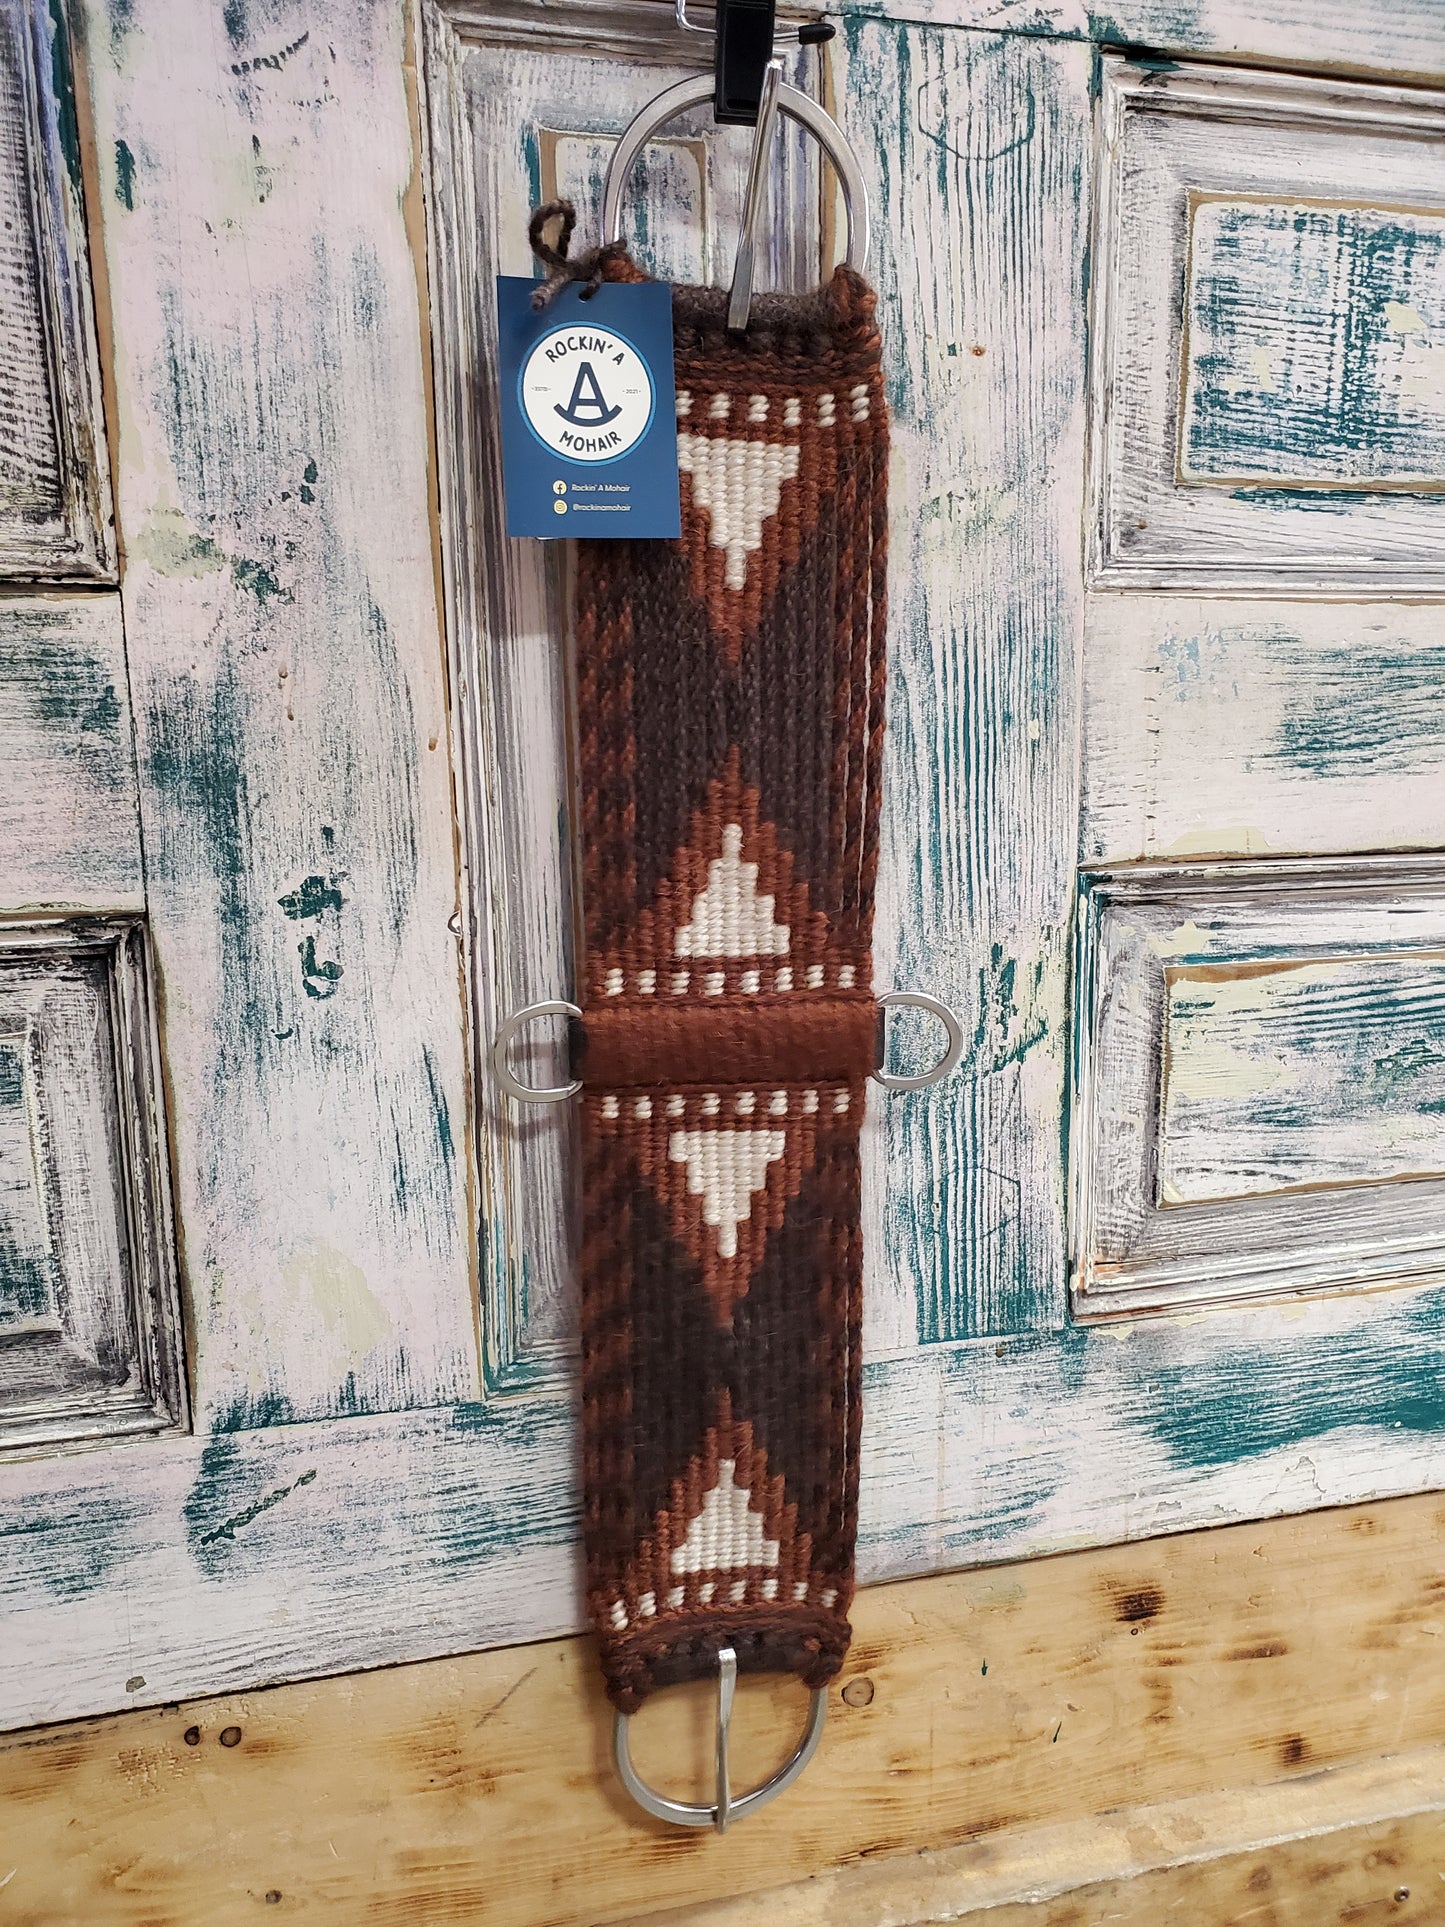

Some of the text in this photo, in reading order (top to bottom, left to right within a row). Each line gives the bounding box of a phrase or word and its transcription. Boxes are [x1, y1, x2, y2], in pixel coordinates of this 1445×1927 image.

[545, 336, 625, 365] ROCKIN' A
[553, 362, 622, 428] A
[559, 430, 622, 452] MOHAIR
[571, 483, 597, 491] Rockin'
[604, 484, 631, 492] Mohair
[572, 503, 632, 511] @rockinamohair
